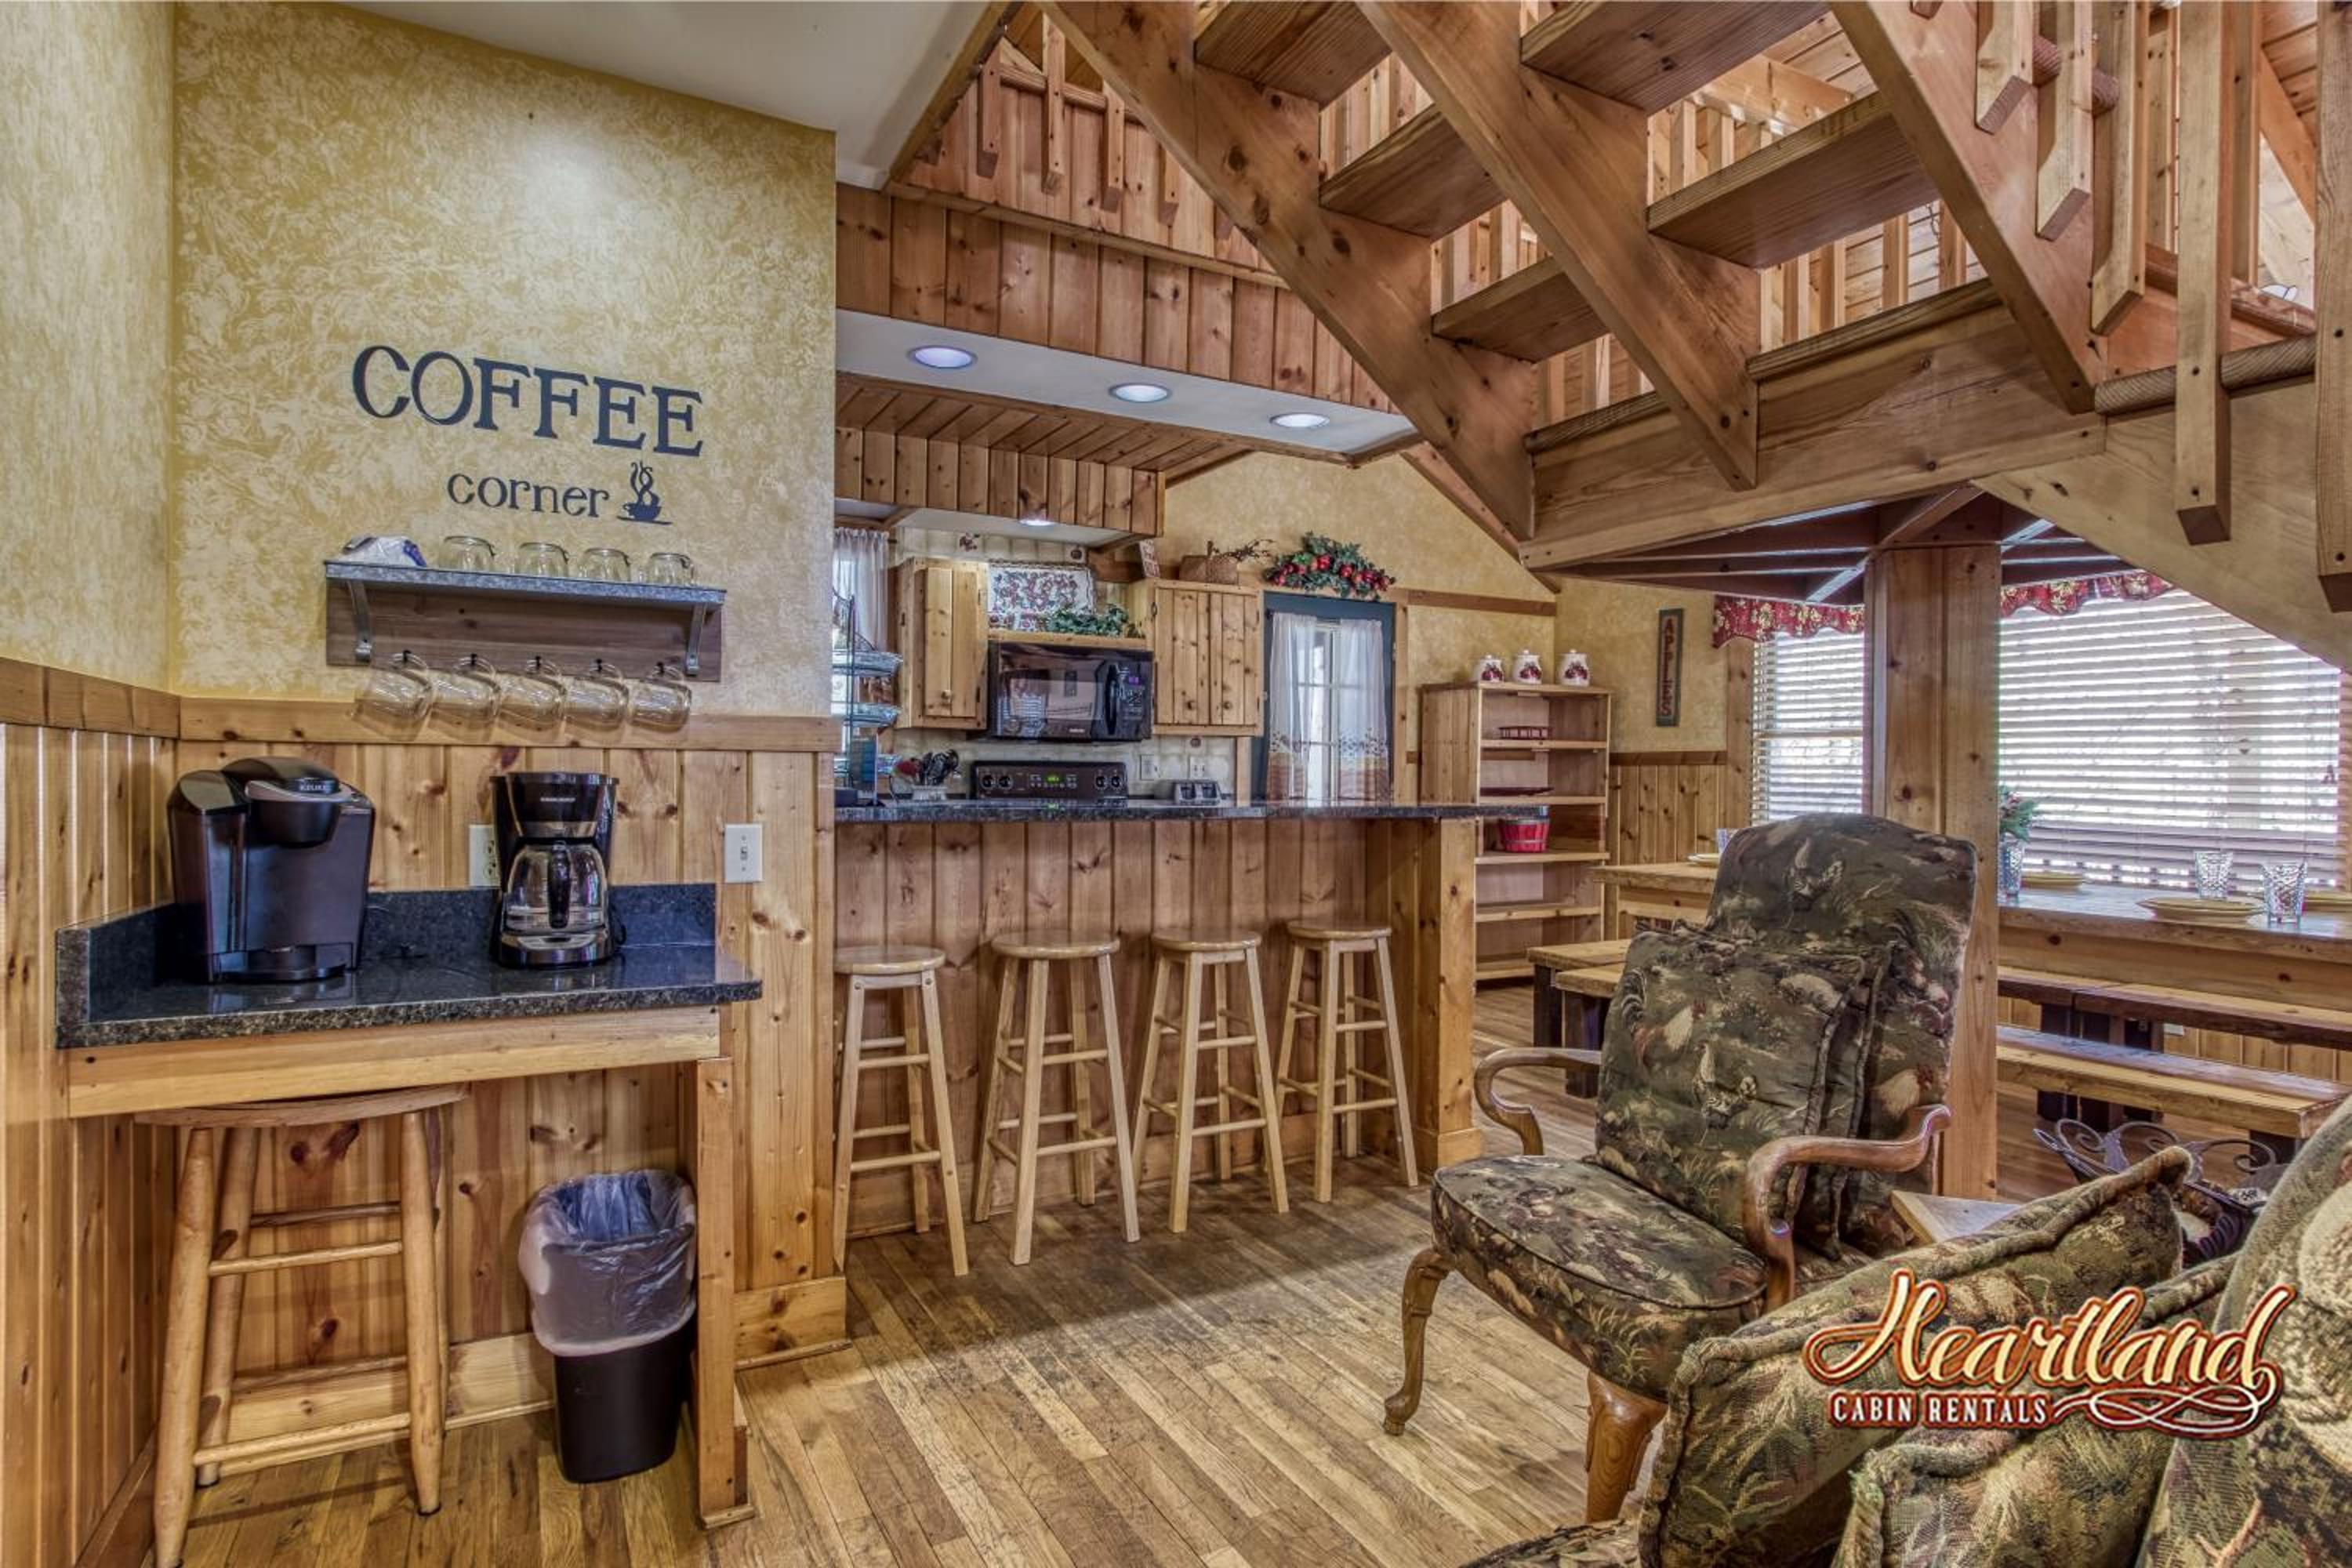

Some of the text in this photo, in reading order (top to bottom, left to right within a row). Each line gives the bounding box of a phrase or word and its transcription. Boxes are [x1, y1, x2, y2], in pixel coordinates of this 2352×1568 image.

[352, 345, 703, 457] COFFEE
[448, 473, 609, 517] corner
[1661, 617, 1675, 717] APPLES
